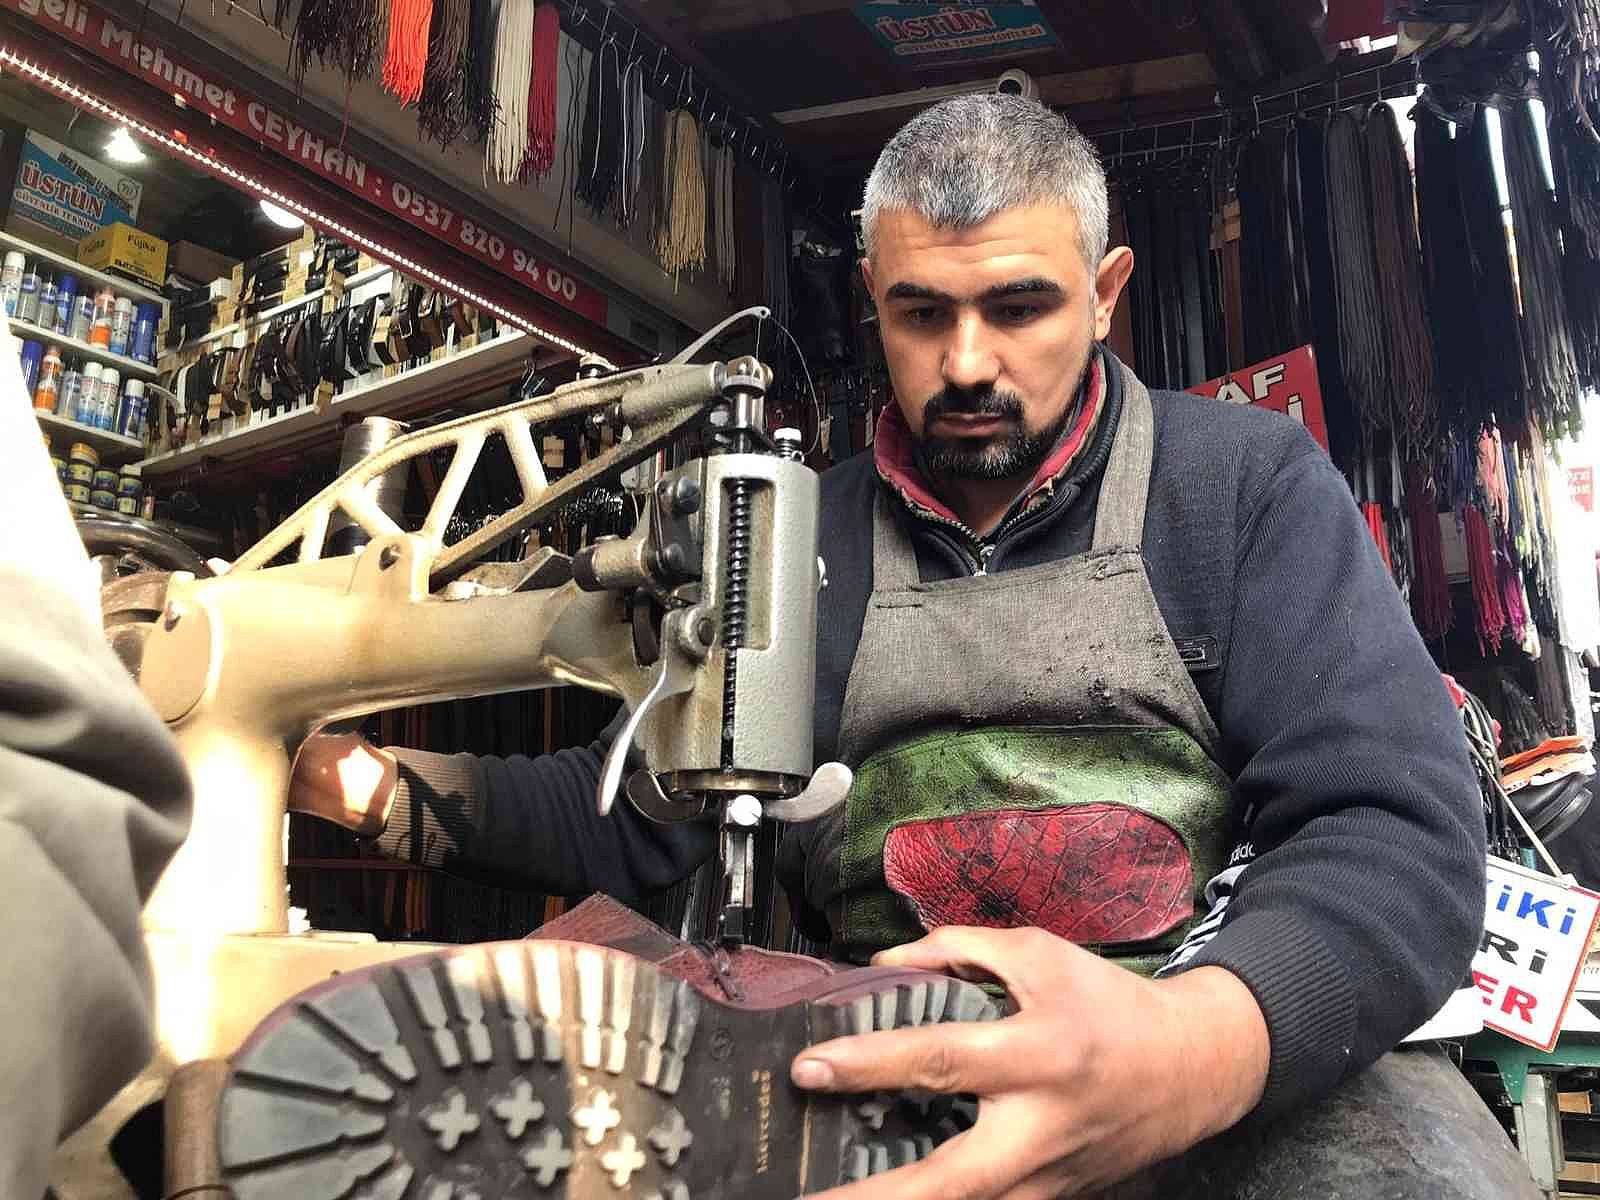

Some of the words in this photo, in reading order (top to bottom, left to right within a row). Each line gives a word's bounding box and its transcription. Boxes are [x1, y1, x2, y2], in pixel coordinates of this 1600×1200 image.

[877, 8, 996, 41] ÜSTÜN
[101, 18, 236, 115] Mehmet
[247, 102, 367, 187] CEYHAN
[392, 182, 454, 231] 0537
[460, 220, 505, 261] 820
[512, 248, 540, 281] 94
[546, 268, 577, 301] 00
[21, 160, 105, 219] ÜSTÜN
